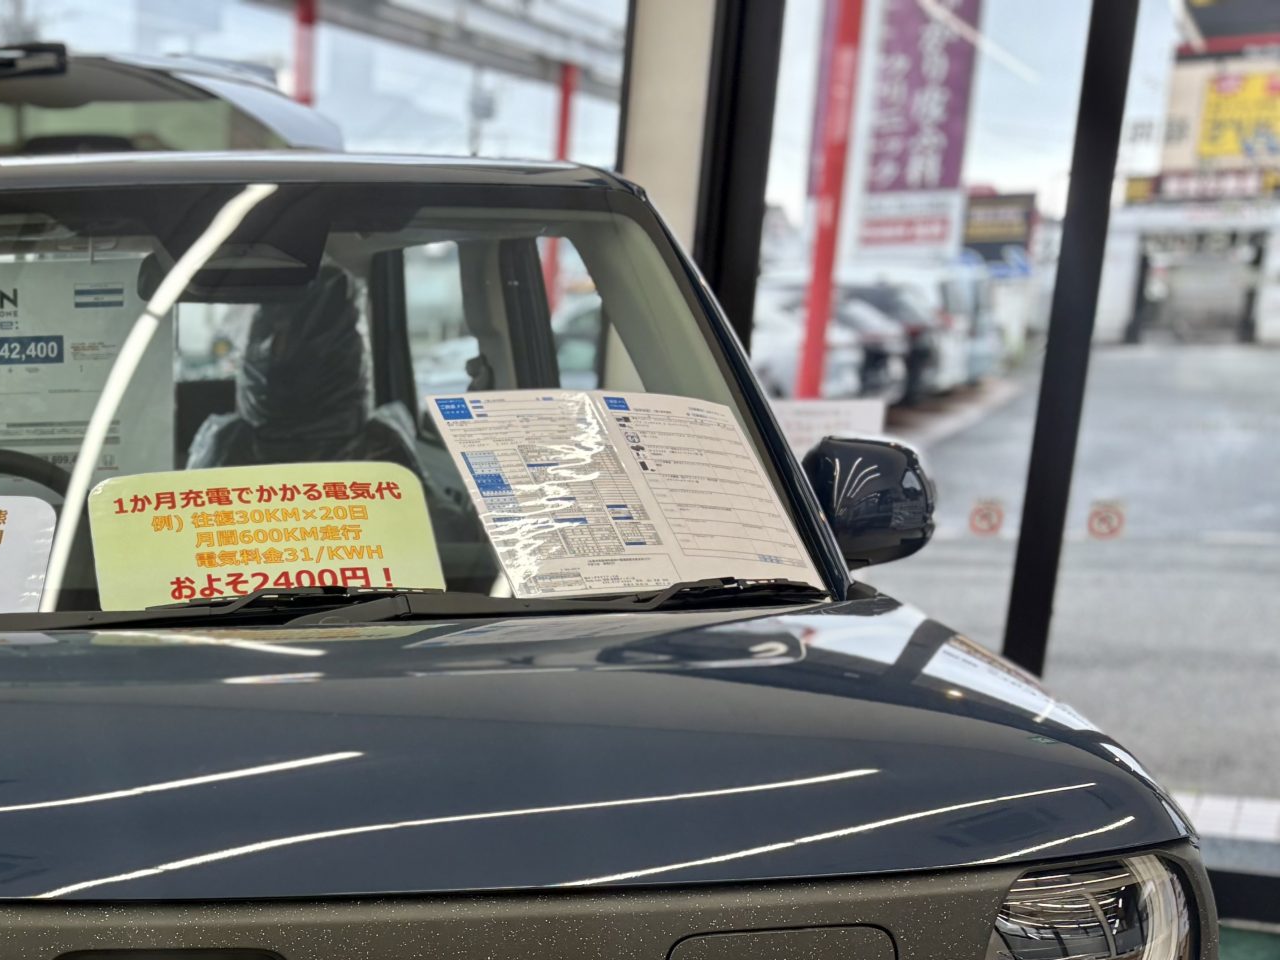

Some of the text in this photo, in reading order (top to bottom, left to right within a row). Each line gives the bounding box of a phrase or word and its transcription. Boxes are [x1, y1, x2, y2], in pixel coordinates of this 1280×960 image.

[0, 288, 18, 309] N
[113, 480, 403, 515] 1か月充電でかかる電気代
[195, 525, 363, 548] 月間600KM走行
[195, 544, 384, 569] 電気料金31/KWH
